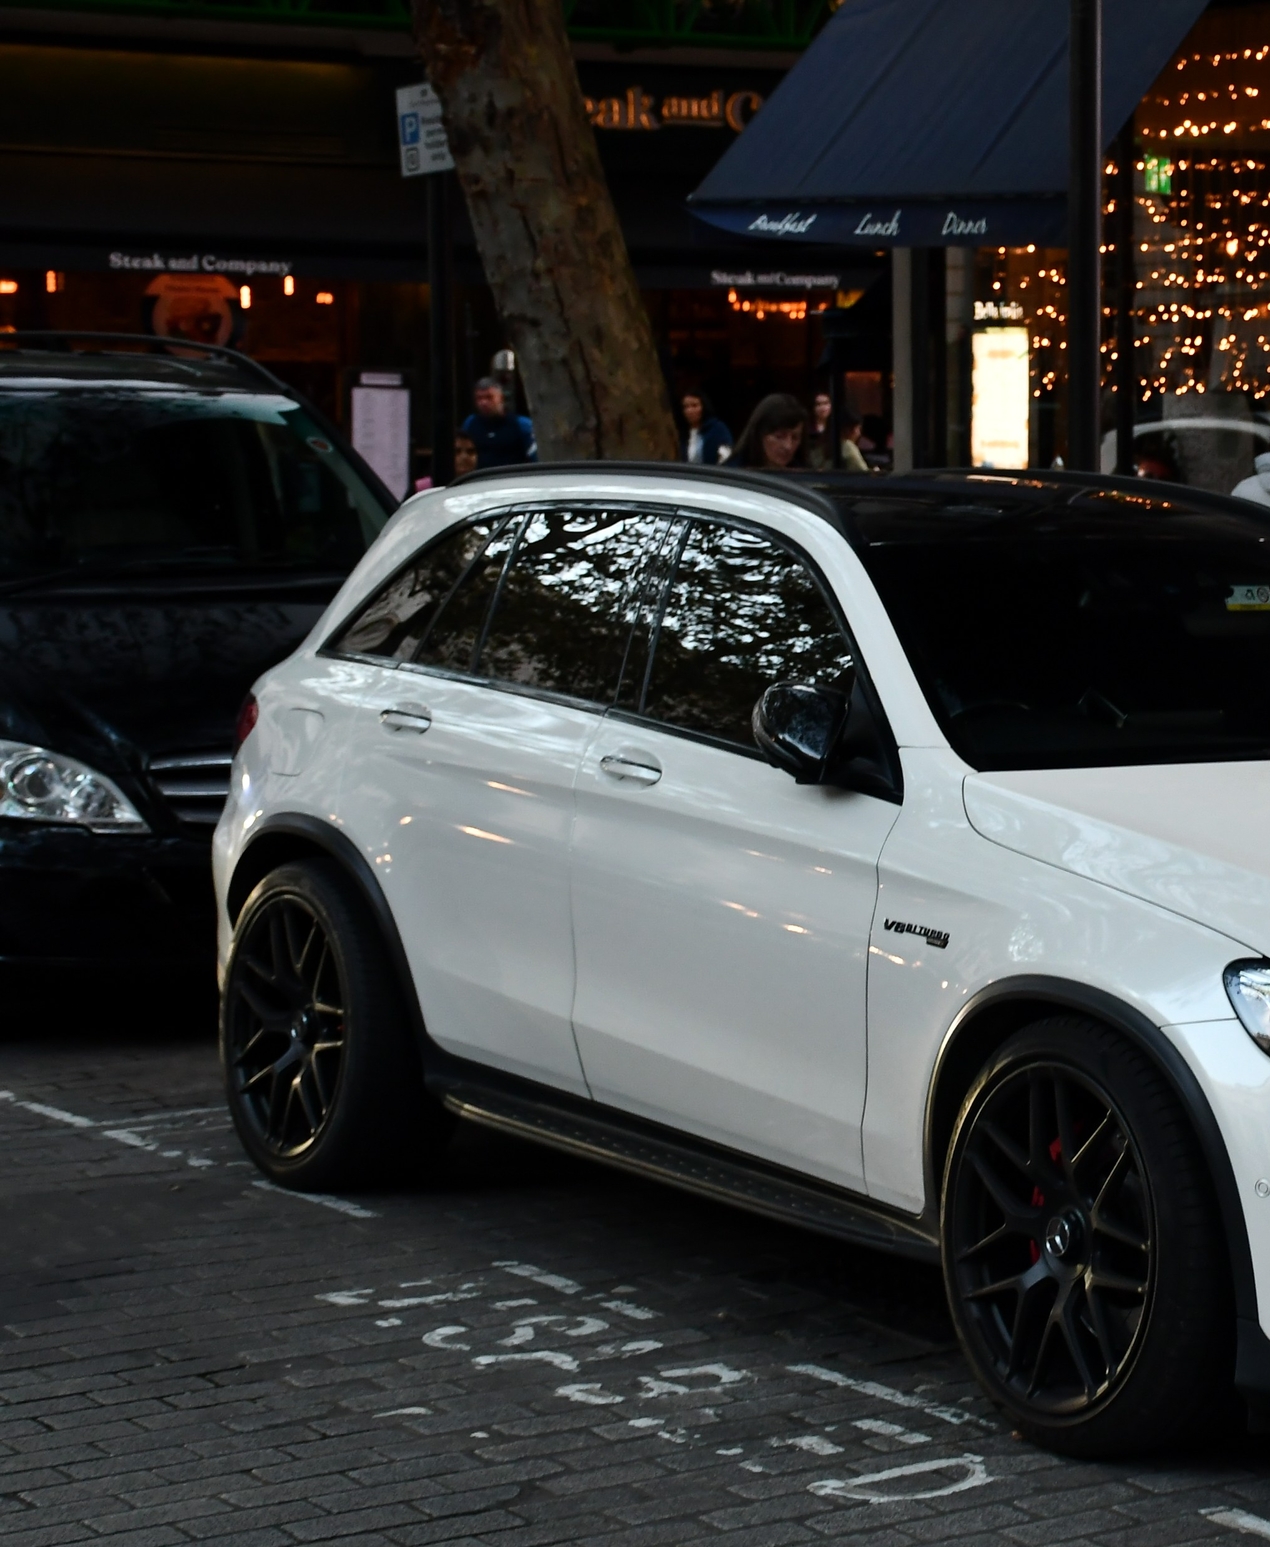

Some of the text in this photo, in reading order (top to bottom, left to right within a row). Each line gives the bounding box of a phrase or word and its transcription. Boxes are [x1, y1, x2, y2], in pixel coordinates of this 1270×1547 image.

[854, 209, 901, 236] Lunch
[941, 210, 988, 235] Dinner
[109, 252, 292, 276] Steak and Company
